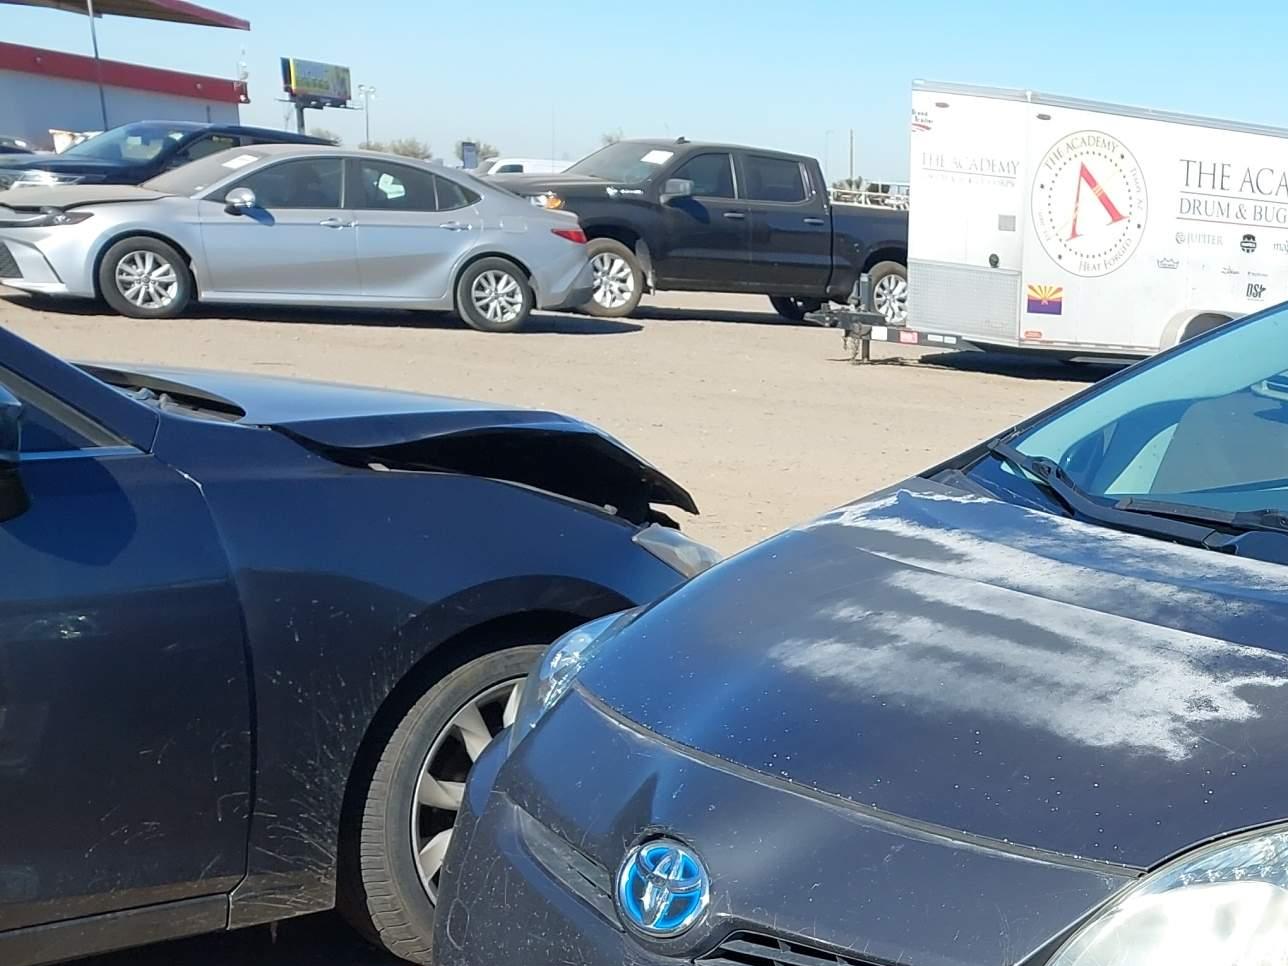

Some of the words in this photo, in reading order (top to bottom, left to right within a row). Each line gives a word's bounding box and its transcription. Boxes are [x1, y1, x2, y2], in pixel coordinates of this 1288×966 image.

[1065, 135, 1119, 153] ACADEMY
[1179, 158, 1232, 191] THE
[1179, 197, 1231, 219] DRUM
[1235, 203, 1248, 221] &
